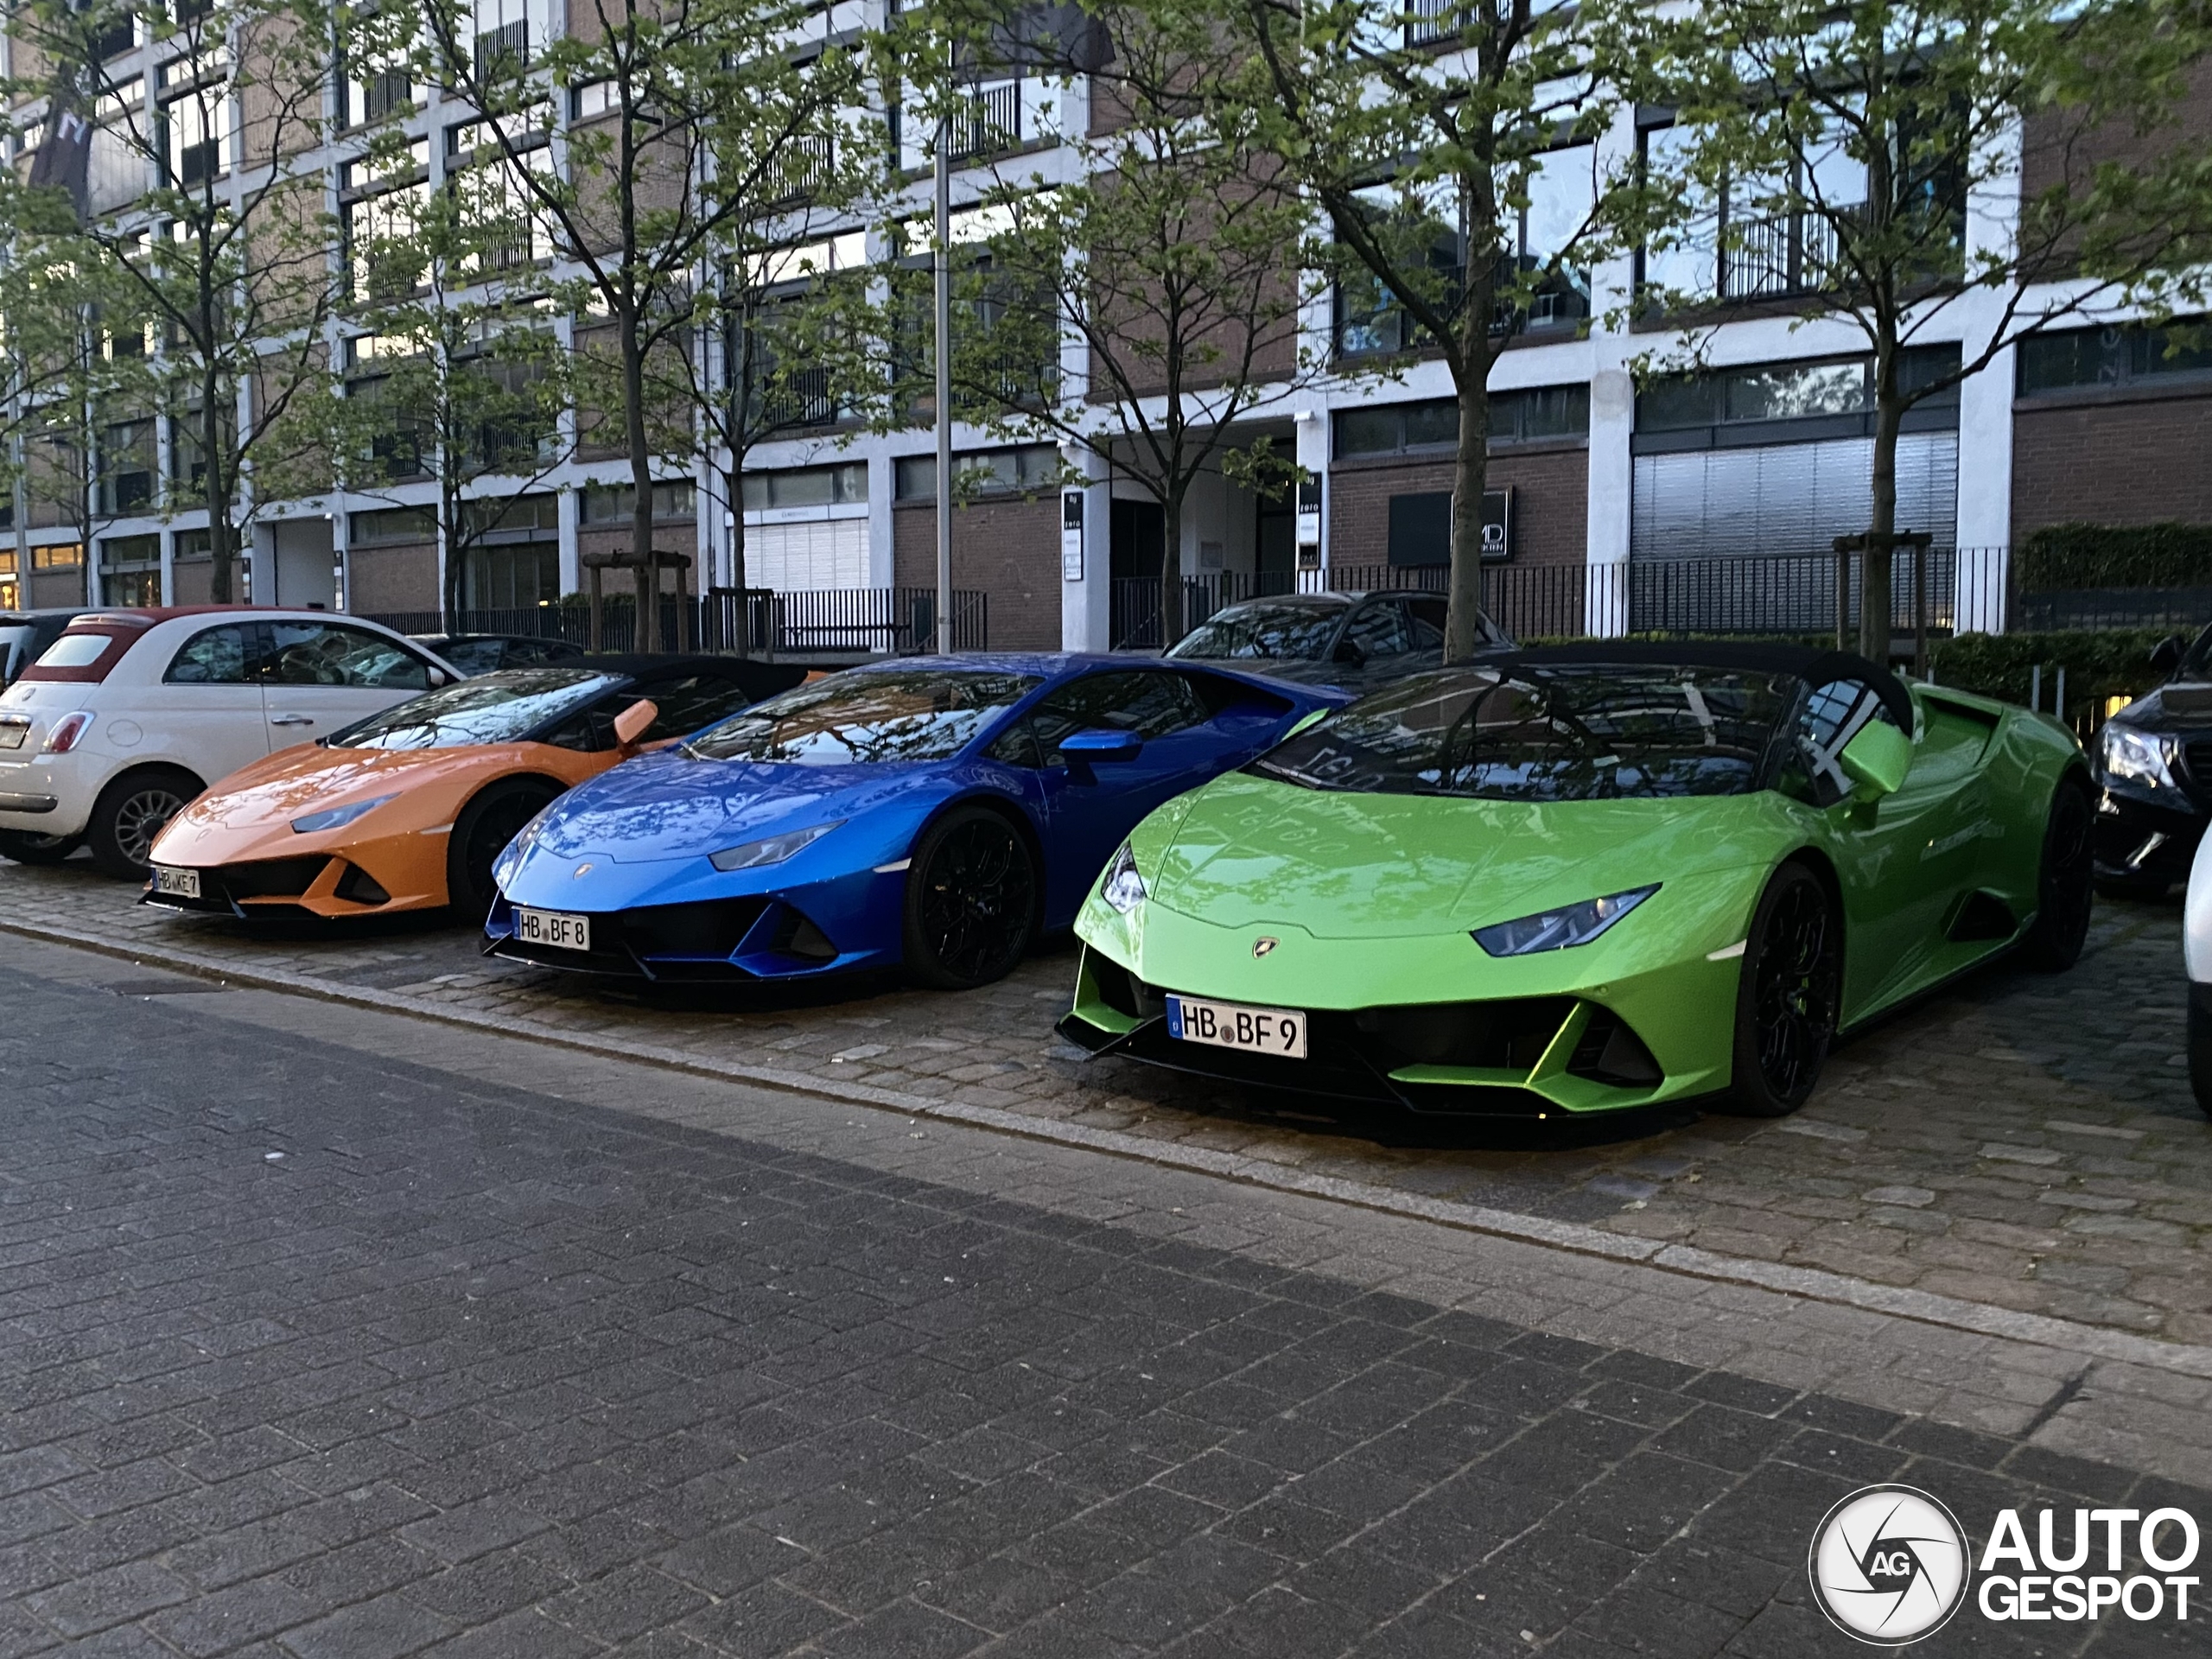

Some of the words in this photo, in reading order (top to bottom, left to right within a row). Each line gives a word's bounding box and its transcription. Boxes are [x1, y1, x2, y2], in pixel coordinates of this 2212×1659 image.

[158, 871, 171, 889] HB
[190, 875, 196, 893] 7
[520, 913, 541, 938] HB
[550, 918, 571, 943] BF
[575, 922, 585, 945] 8
[1182, 1004, 1217, 1039] HB
[1236, 1012, 1272, 1046] BF
[1279, 1019, 1297, 1051] 9
